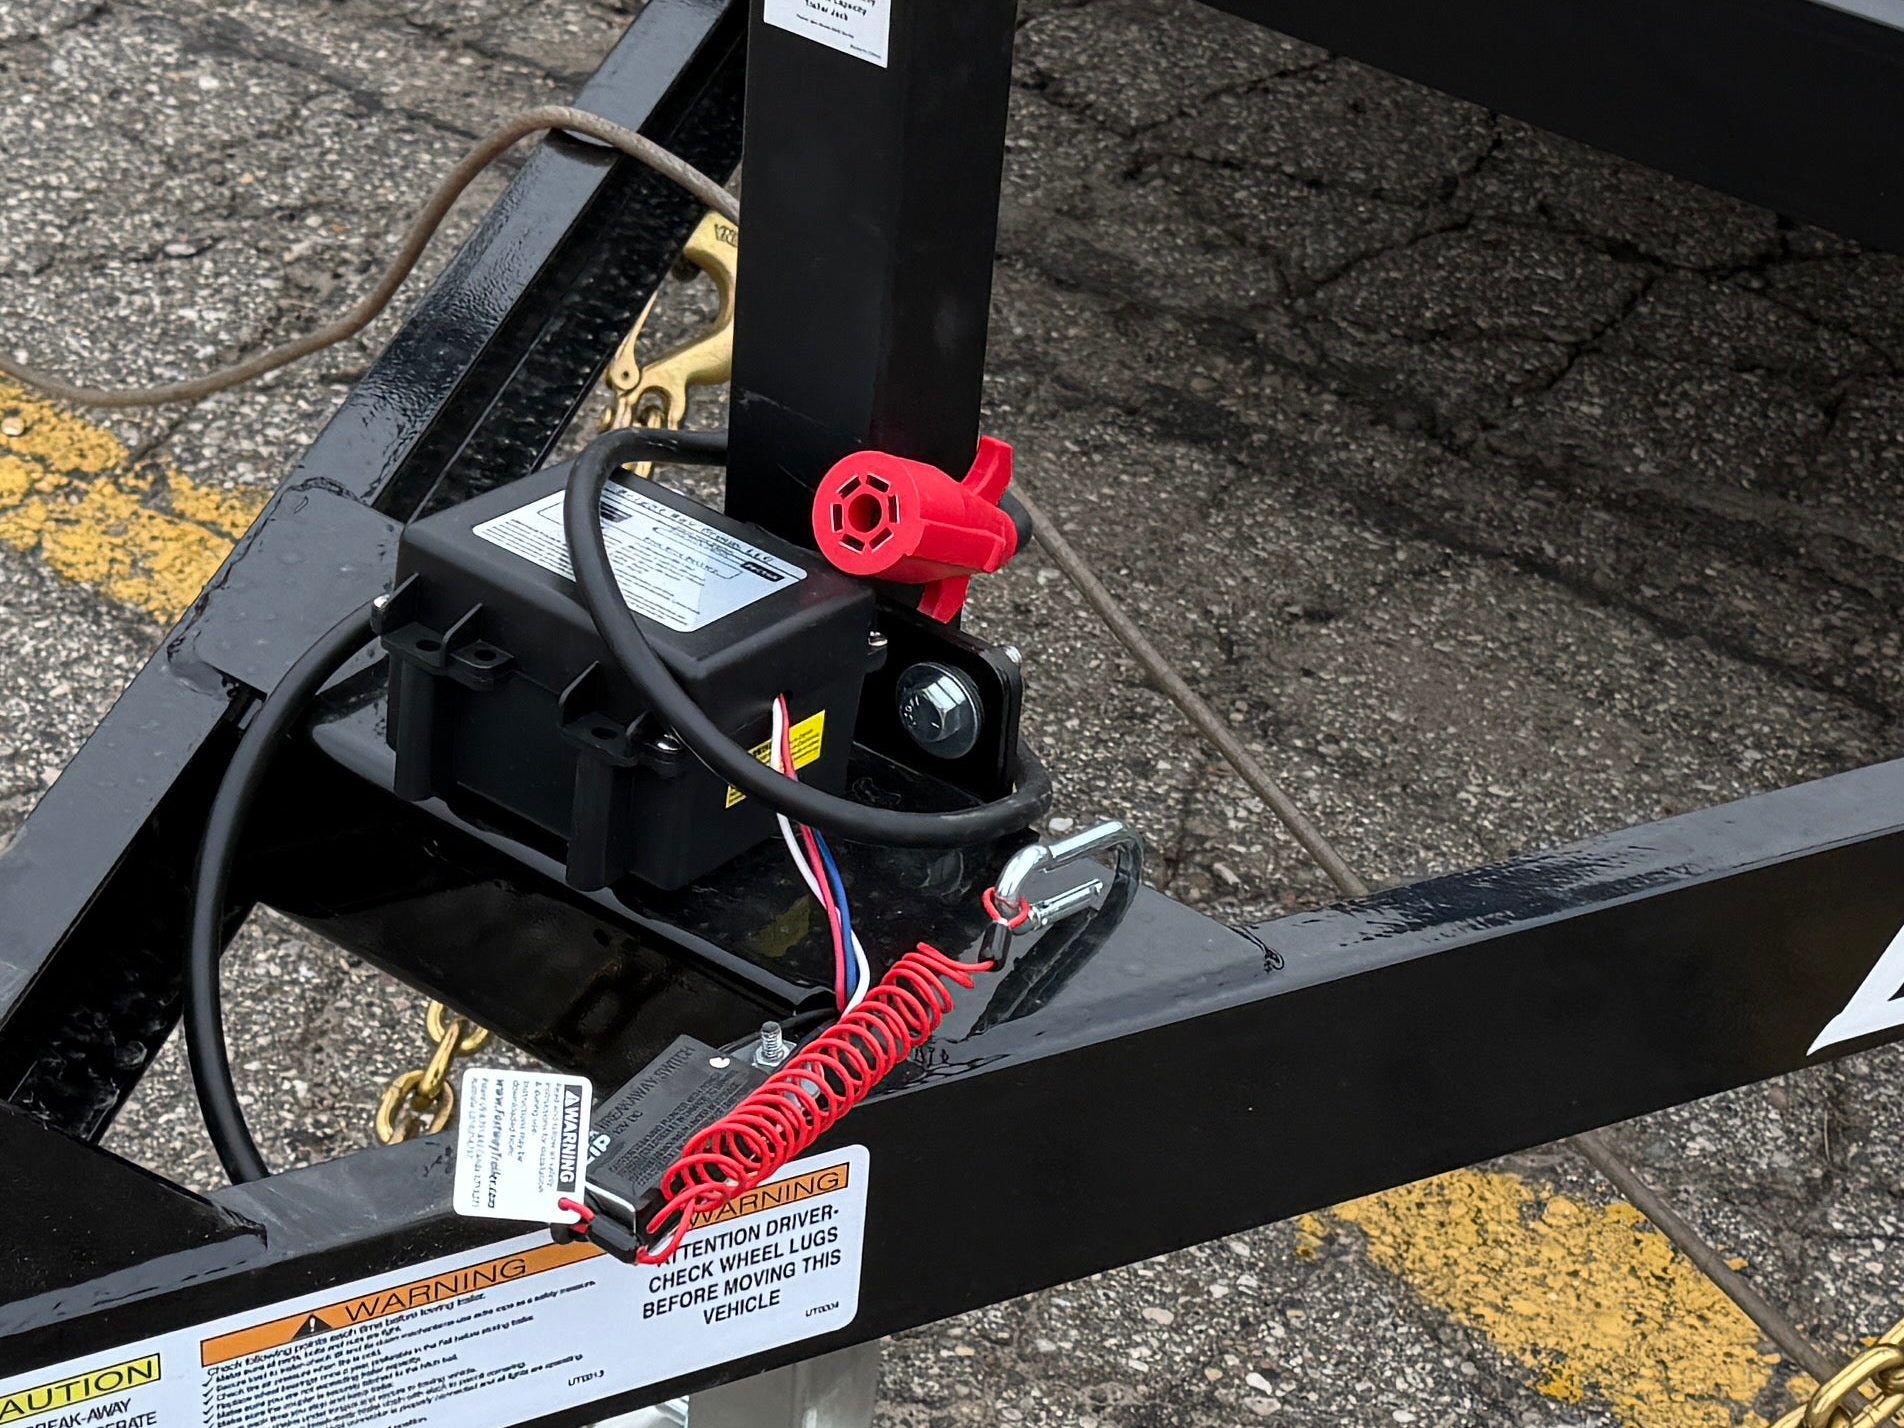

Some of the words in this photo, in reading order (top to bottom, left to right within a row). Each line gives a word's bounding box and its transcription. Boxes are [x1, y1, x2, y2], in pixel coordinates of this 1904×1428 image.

[559, 1106, 579, 1184] WARNING
[648, 1260, 714, 1294] CHECK
[719, 1242, 785, 1274] WHEEL
[789, 1226, 839, 1254] LUGS
[657, 1224, 761, 1268] TTENTION
[345, 1258, 527, 1322] WARNING
[642, 1283, 719, 1320] BEFORE
[723, 1262, 796, 1297] MOVING
[801, 1248, 842, 1275] THIS
[703, 1288, 782, 1325] VEHICLE
